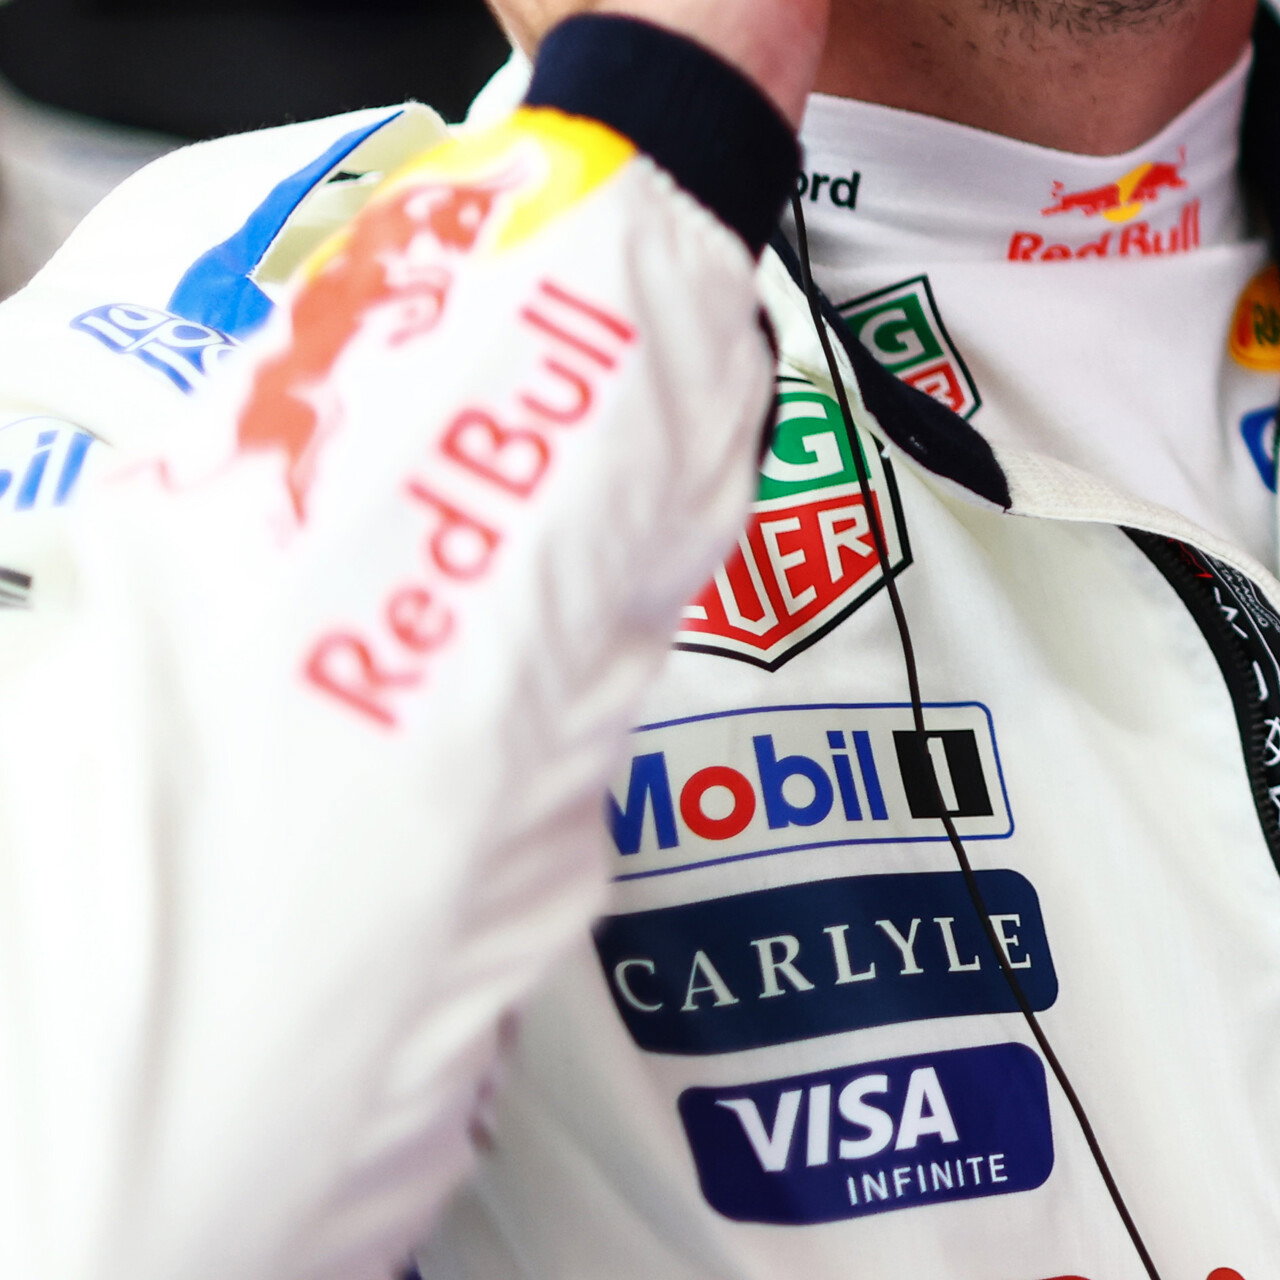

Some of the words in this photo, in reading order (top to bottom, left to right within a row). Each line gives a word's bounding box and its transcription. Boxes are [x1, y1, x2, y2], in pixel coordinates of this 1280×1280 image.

[300, 475, 503, 733] Red
[437, 275, 641, 507] Bull
[678, 503, 876, 636] UER
[606, 730, 889, 856] Mobil
[613, 913, 1033, 1013] CARLYLE
[715, 1066, 960, 1173] VISA
[847, 1153, 1009, 1207] INFINITE
